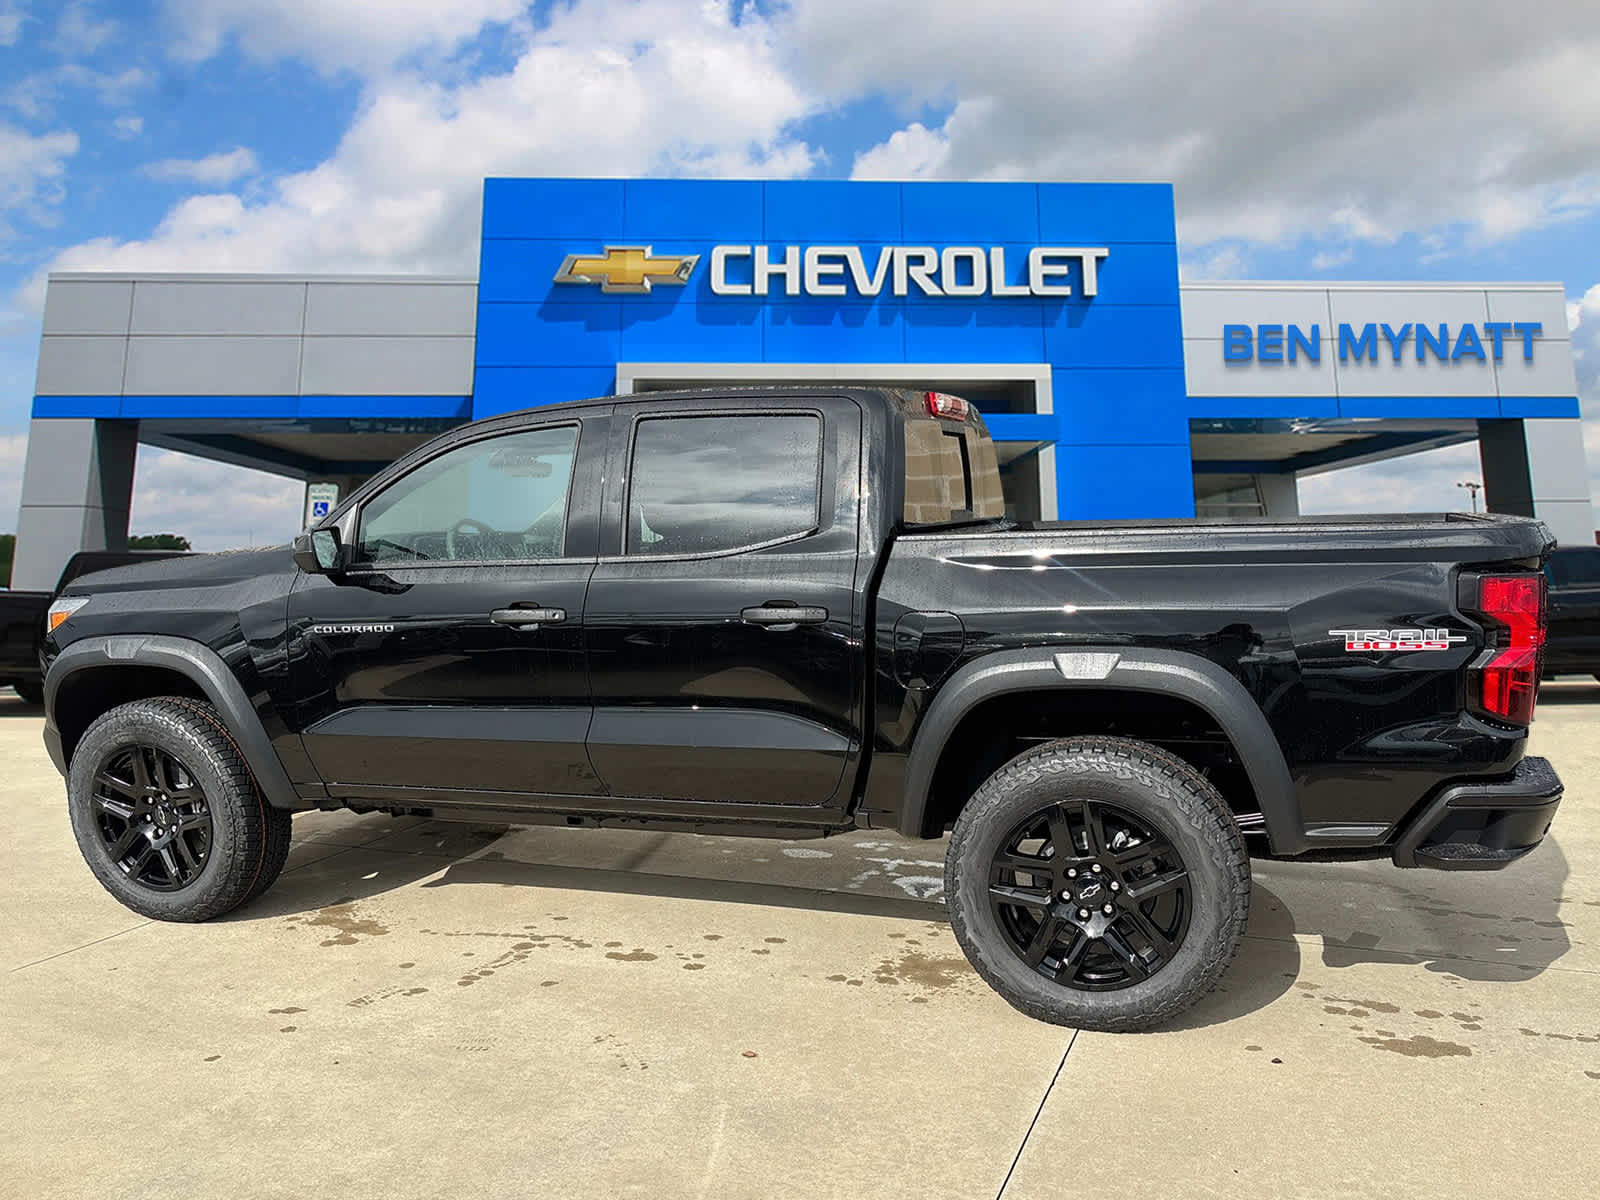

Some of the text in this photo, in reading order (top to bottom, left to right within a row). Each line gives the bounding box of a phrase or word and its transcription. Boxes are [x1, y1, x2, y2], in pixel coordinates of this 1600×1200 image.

[710, 244, 1109, 298] CHEVROLET
[1223, 321, 1543, 365] BEN MYNATT
[313, 624, 394, 634] COLORADO
[1328, 628, 1467, 642] TRAIL
[1345, 640, 1449, 652] BOSS
